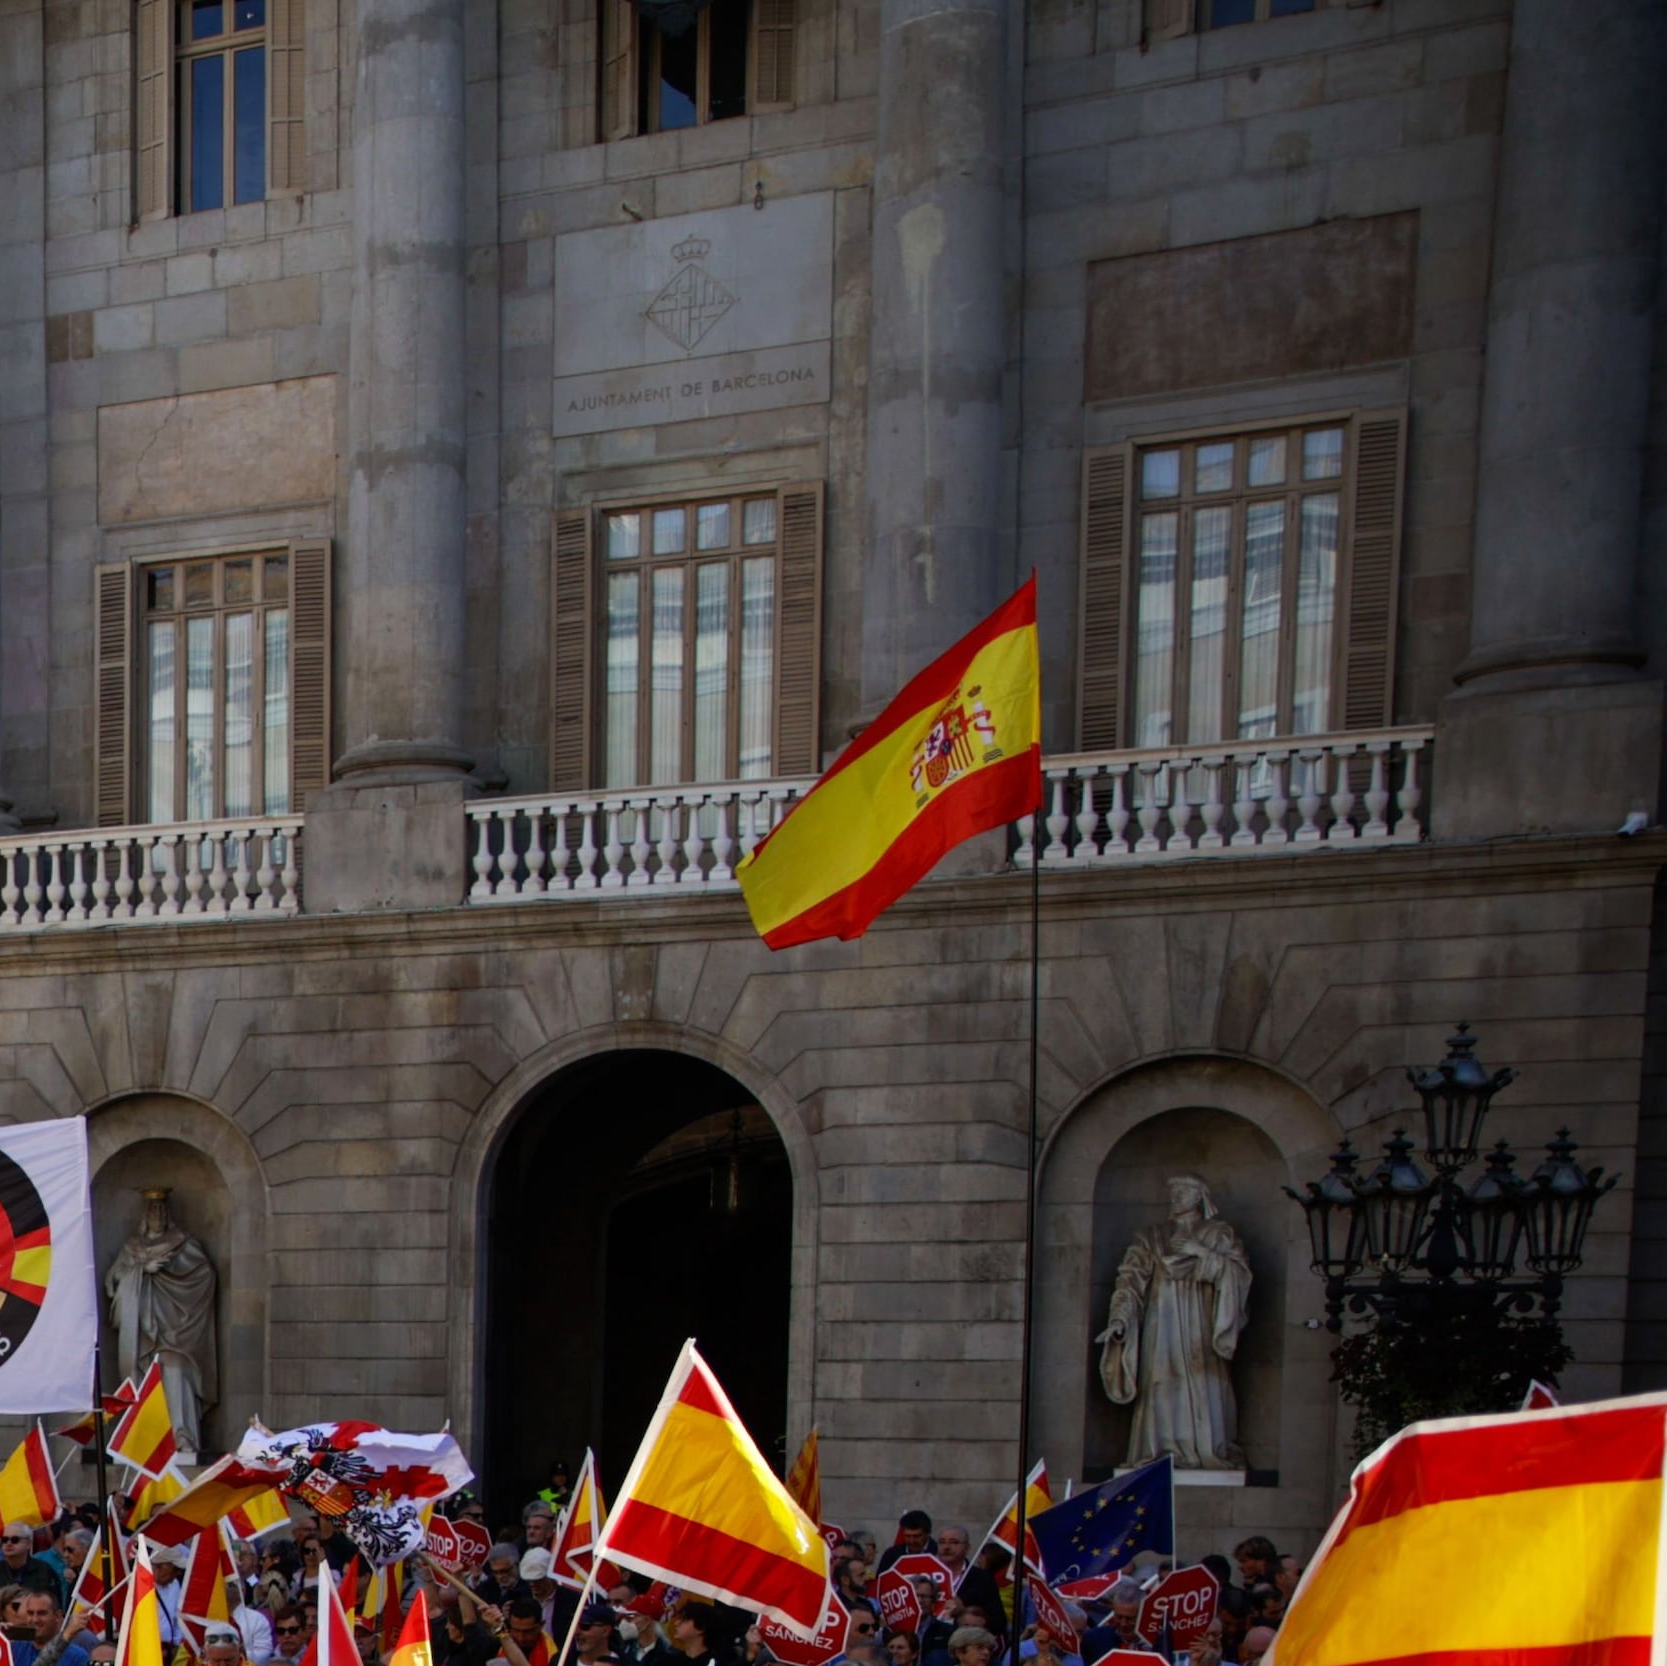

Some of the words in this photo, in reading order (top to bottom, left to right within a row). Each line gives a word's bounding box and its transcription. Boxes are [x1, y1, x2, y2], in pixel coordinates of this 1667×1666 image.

[568, 386, 671, 413] AJUNTAMENT
[681, 383, 702, 398] DE
[712, 367, 815, 393] BARCELONA
[427, 1533, 454, 1556] STOP
[881, 1586, 909, 1613] STOP
[1151, 1587, 1212, 1619] STOP
[1148, 1613, 1210, 1633] SNCHEZ
